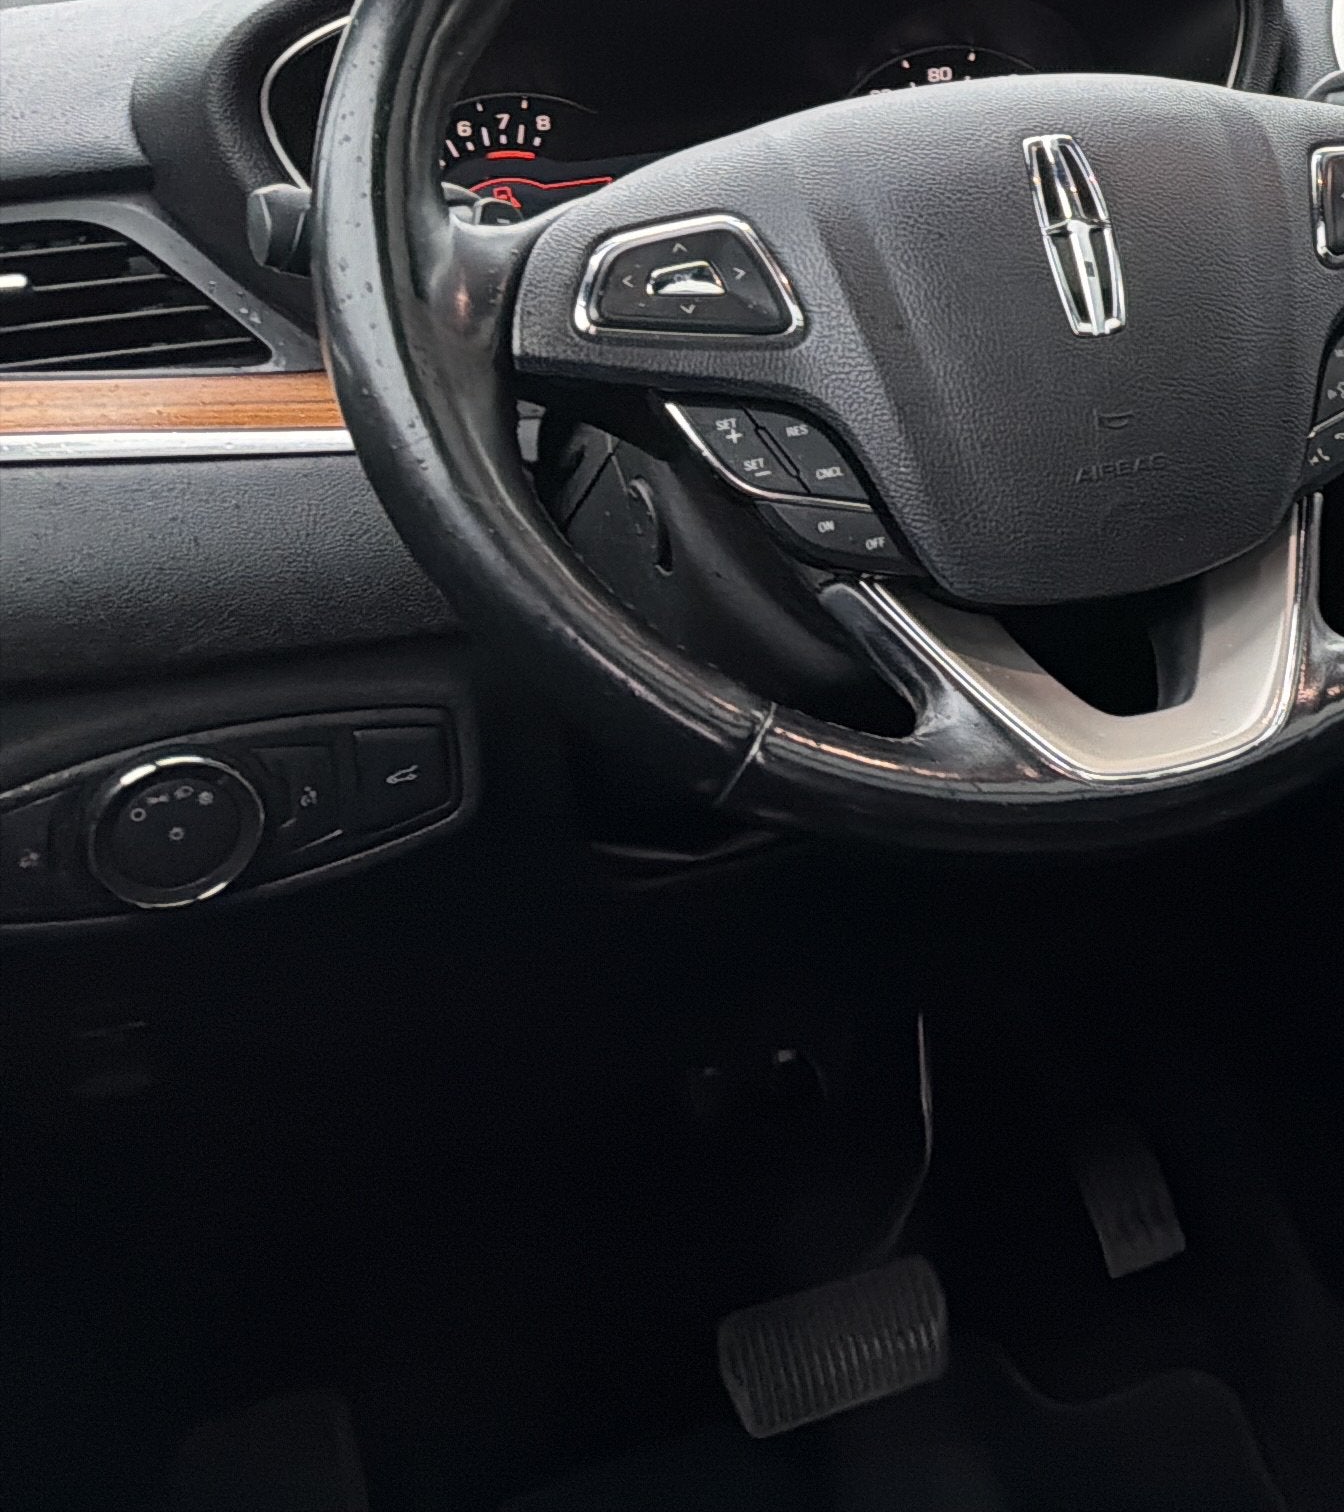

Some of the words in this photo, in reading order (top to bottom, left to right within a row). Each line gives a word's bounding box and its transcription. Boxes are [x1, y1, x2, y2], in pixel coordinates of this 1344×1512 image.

[927, 66, 953, 83] 80
[456, 120, 473, 137] 6
[494, 113, 511, 130] 7
[535, 114, 552, 131] 8
[715, 417, 737, 431] SET
[785, 423, 809, 437] RES
[743, 457, 765, 472] SET
[817, 520, 835, 533] ON
[865, 537, 885, 551] OFF
